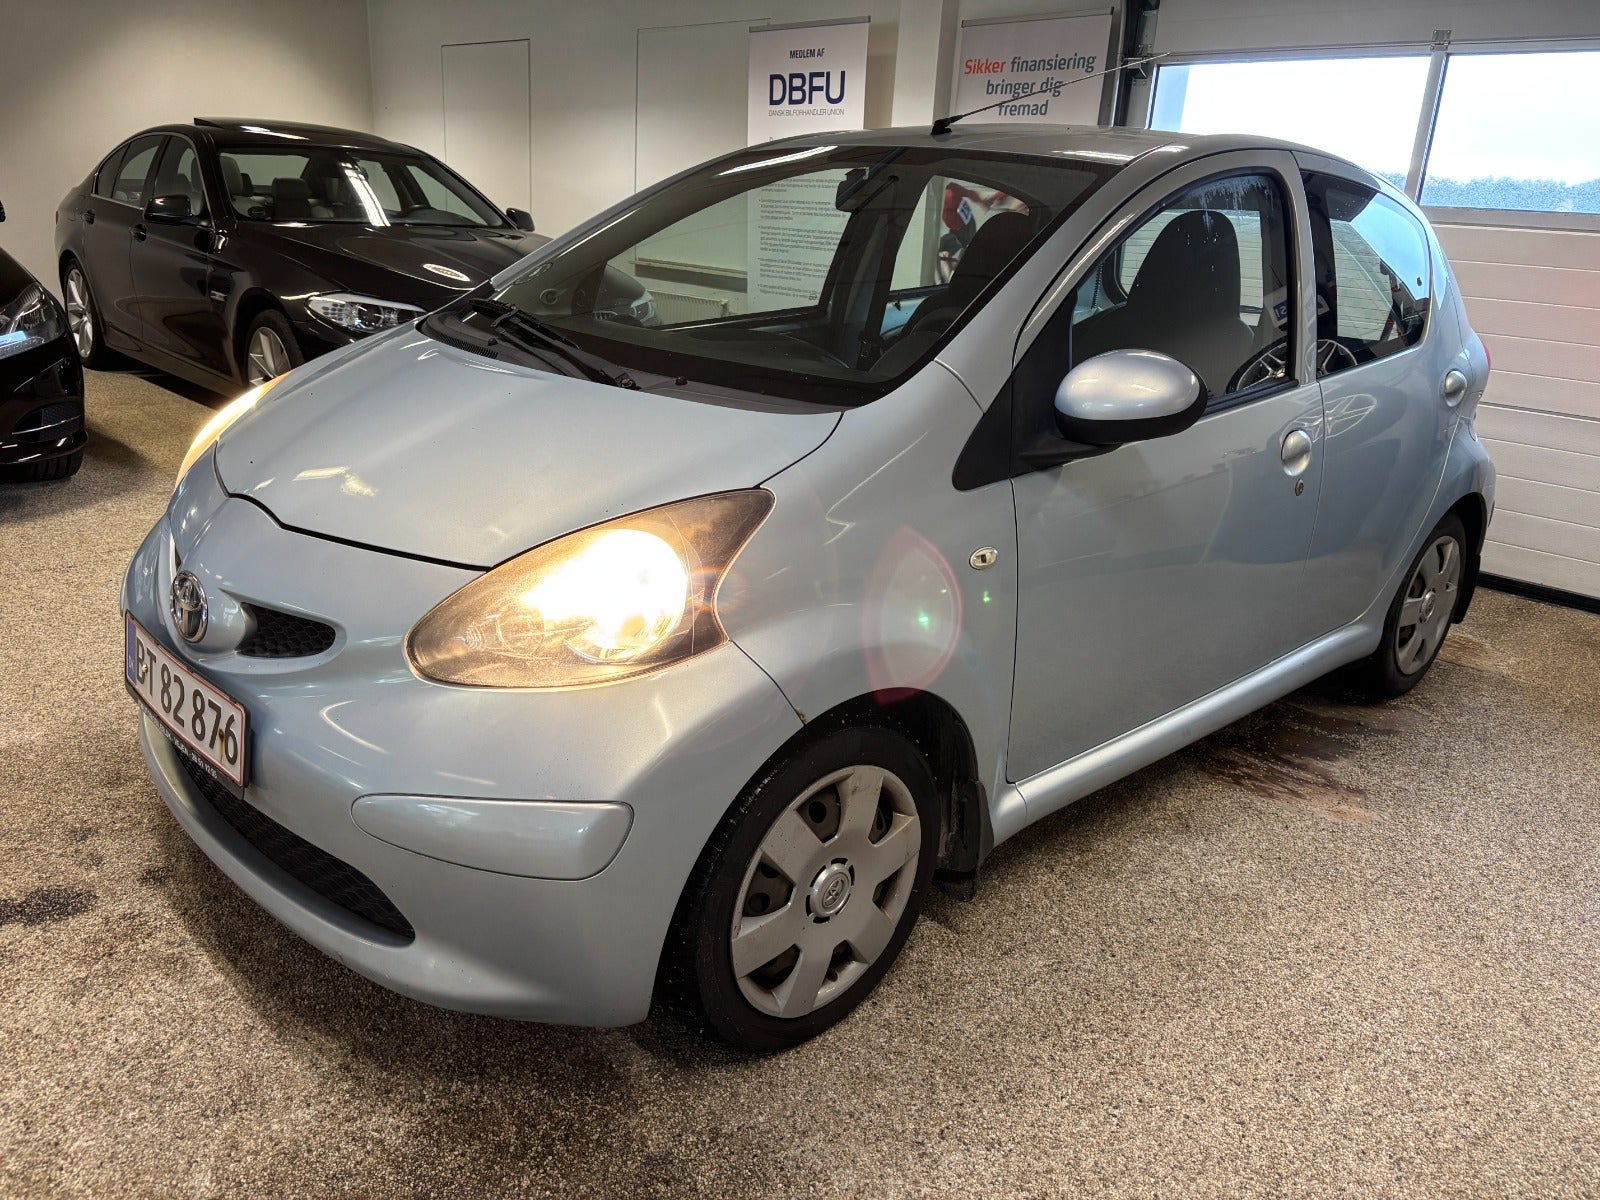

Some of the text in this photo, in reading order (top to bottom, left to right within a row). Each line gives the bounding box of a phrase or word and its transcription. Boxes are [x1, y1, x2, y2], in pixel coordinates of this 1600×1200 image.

[789, 47, 825, 59] MEDLEM AF
[964, 52, 1097, 75] Sikker finansiering
[769, 70, 846, 106] DBFU
[986, 77, 1064, 100] bringer dig
[768, 109, 784, 117] DANSK
[827, 108, 845, 116] UNION
[998, 99, 1049, 117] fremad
[136, 636, 157, 697] BT
[160, 663, 185, 728] 82
[191, 688, 238, 766] 876
